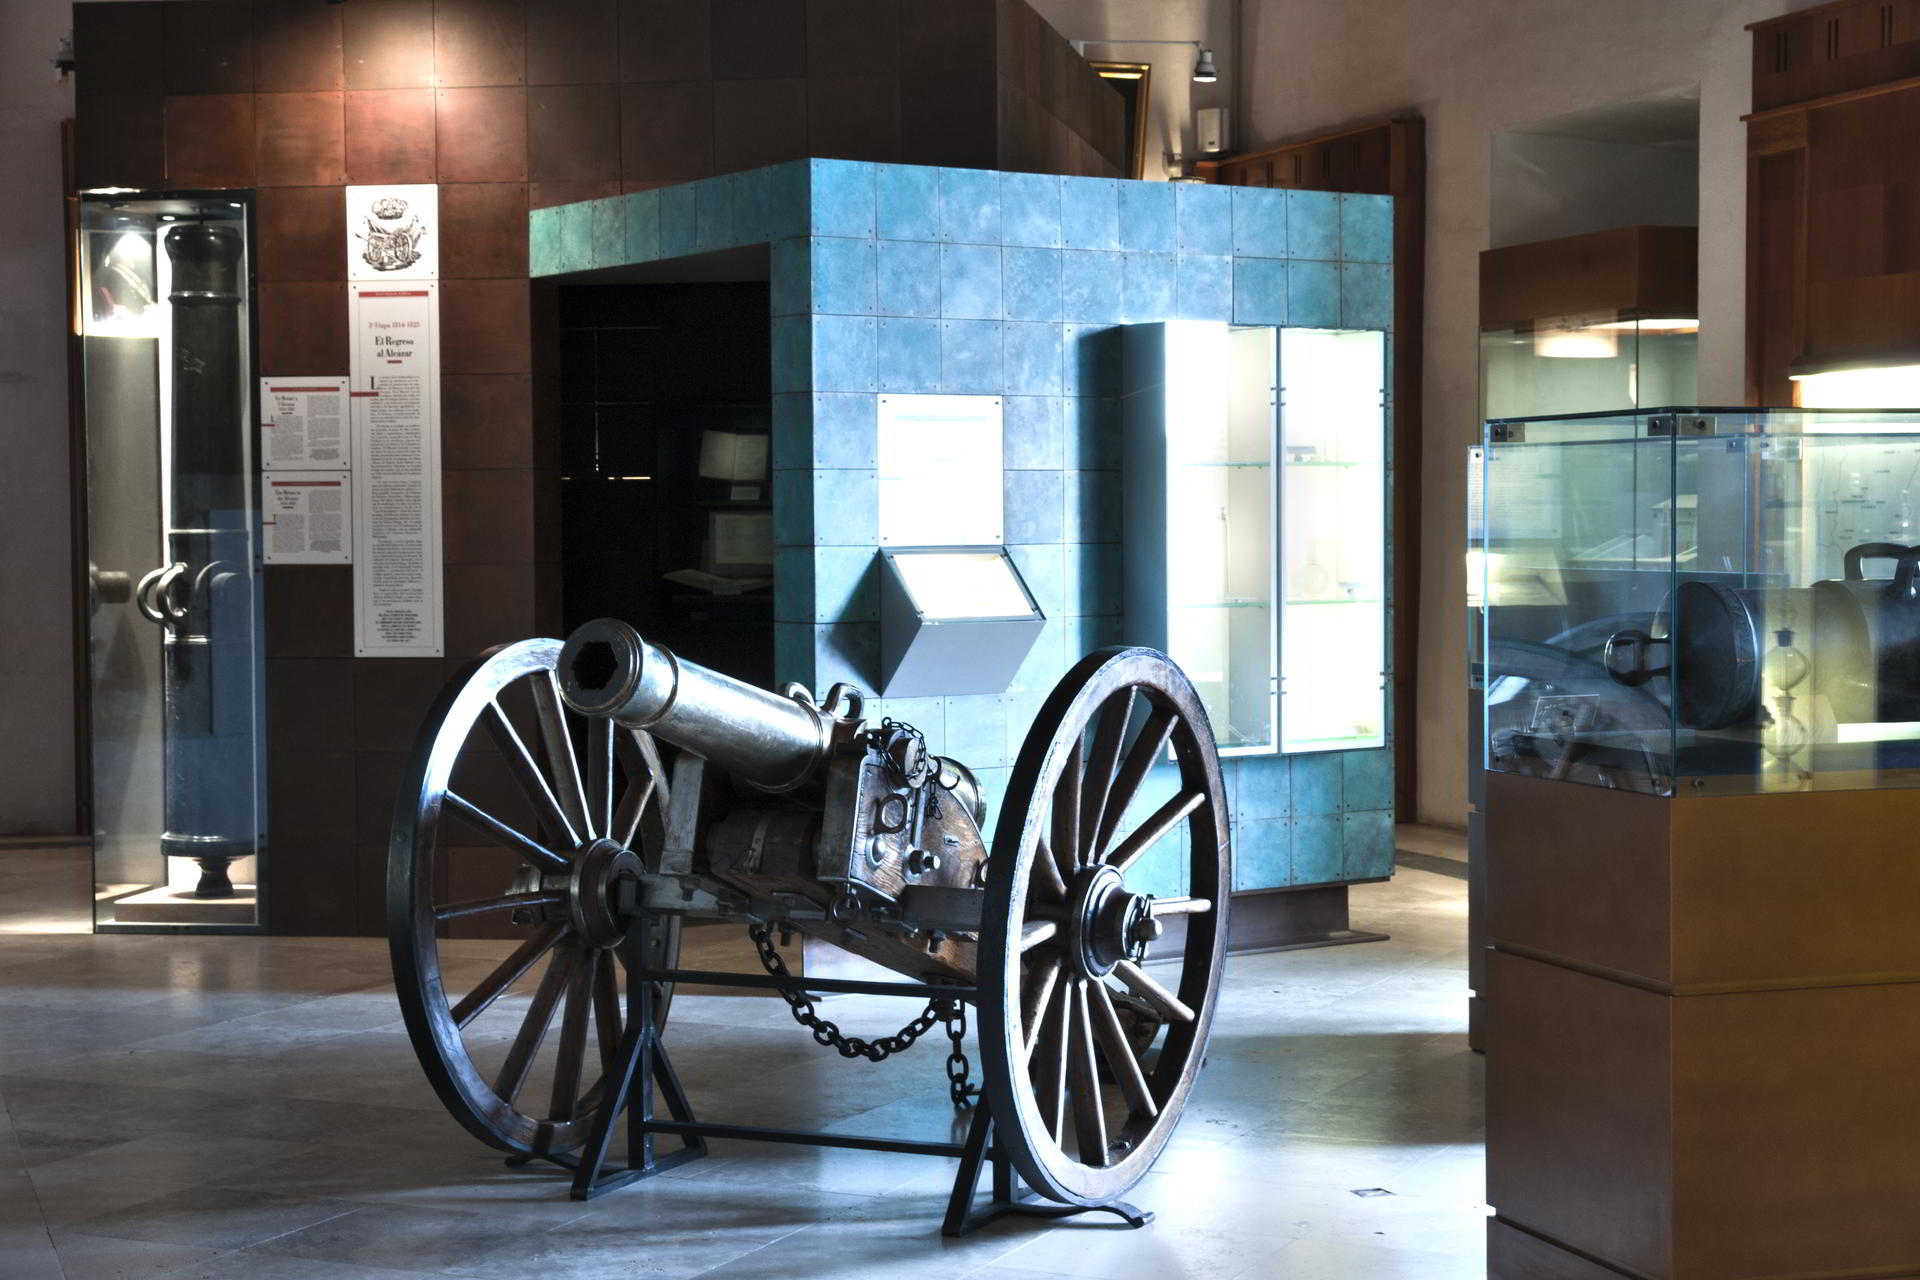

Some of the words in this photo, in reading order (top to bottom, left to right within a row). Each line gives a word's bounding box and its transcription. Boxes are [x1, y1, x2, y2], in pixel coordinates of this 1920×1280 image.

[375, 336, 384, 346] El
[385, 336, 414, 347] Regreso
[376, 348, 384, 357] al
